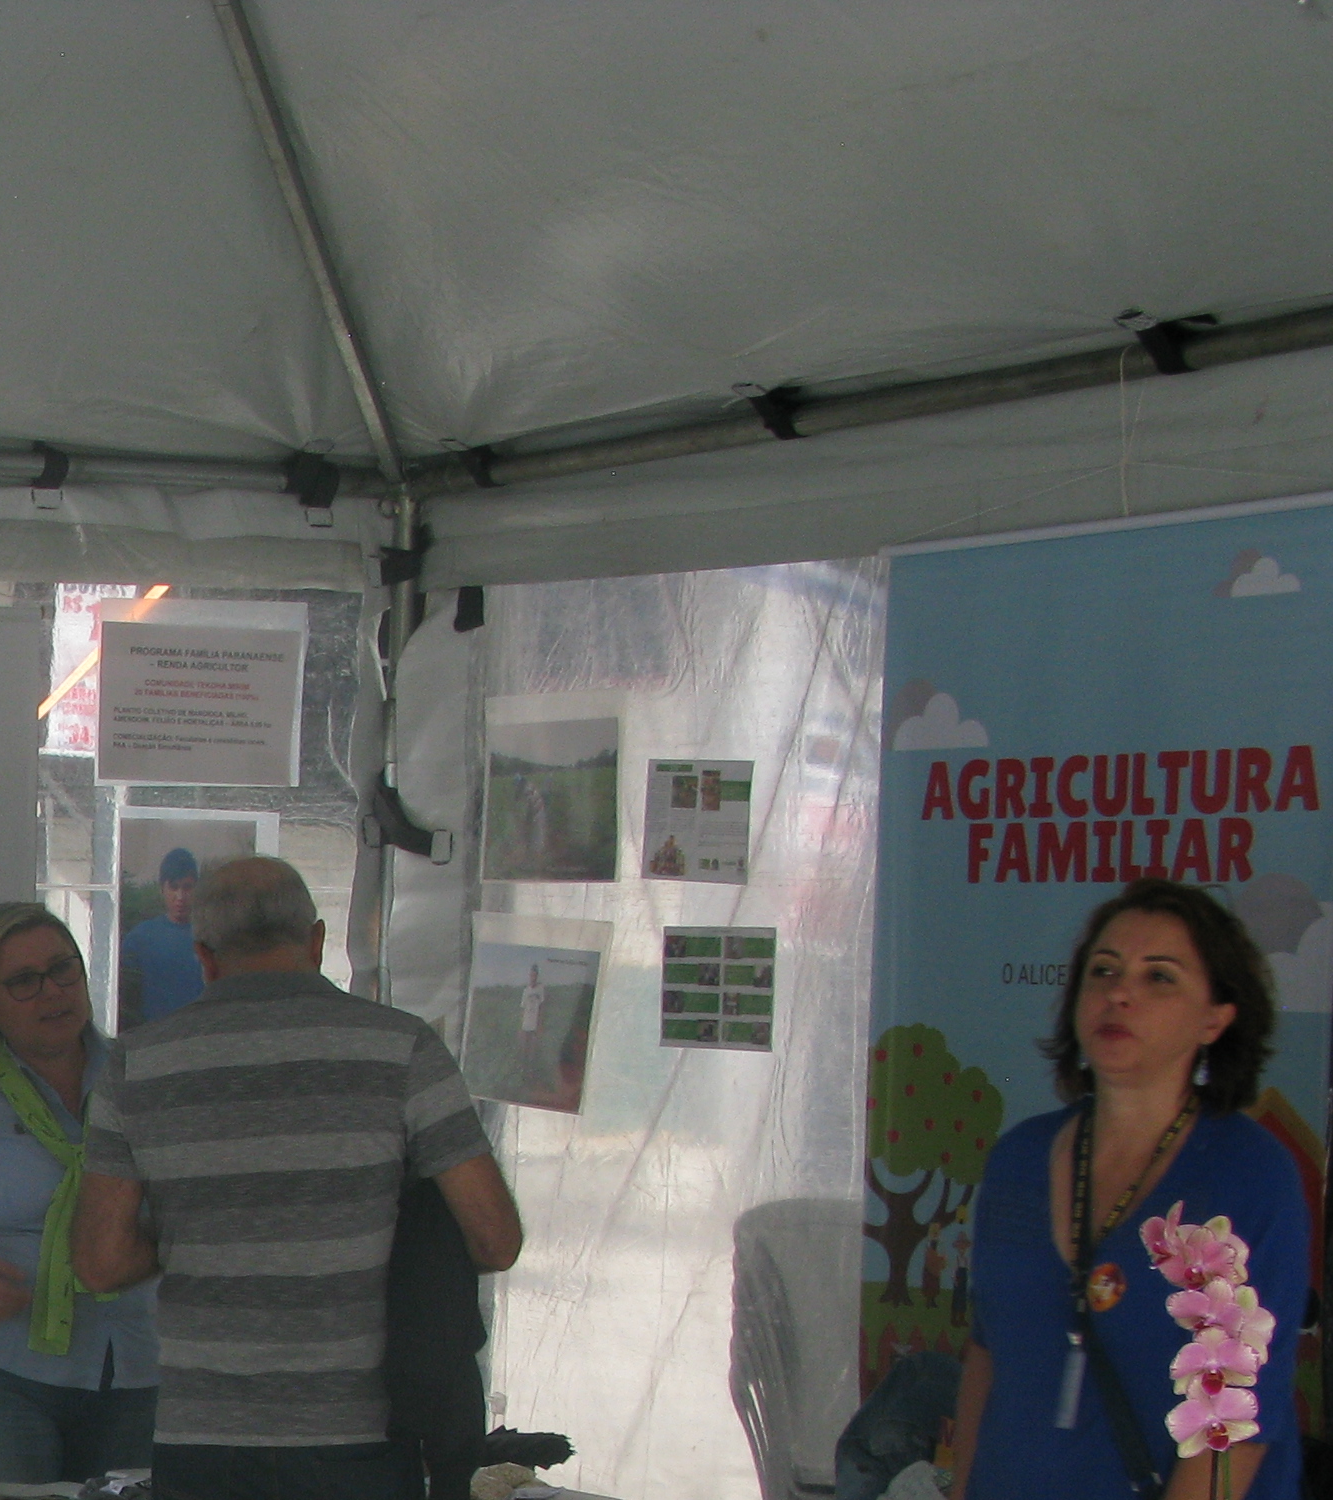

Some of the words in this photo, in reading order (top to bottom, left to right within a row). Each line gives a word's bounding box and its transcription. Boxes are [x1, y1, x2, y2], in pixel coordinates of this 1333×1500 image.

[130, 647, 182, 657] PROGRAMA
[184, 648, 220, 659] FAMÍLIA
[222, 648, 283, 663] PARANAENSE
[157, 660, 188, 670] RENDA
[190, 661, 249, 672] AGRICULTOR
[921, 744, 1320, 821] AGRICULTURA
[967, 817, 1253, 884] FAMILIAR
[1018, 964, 1068, 985] ALICE
